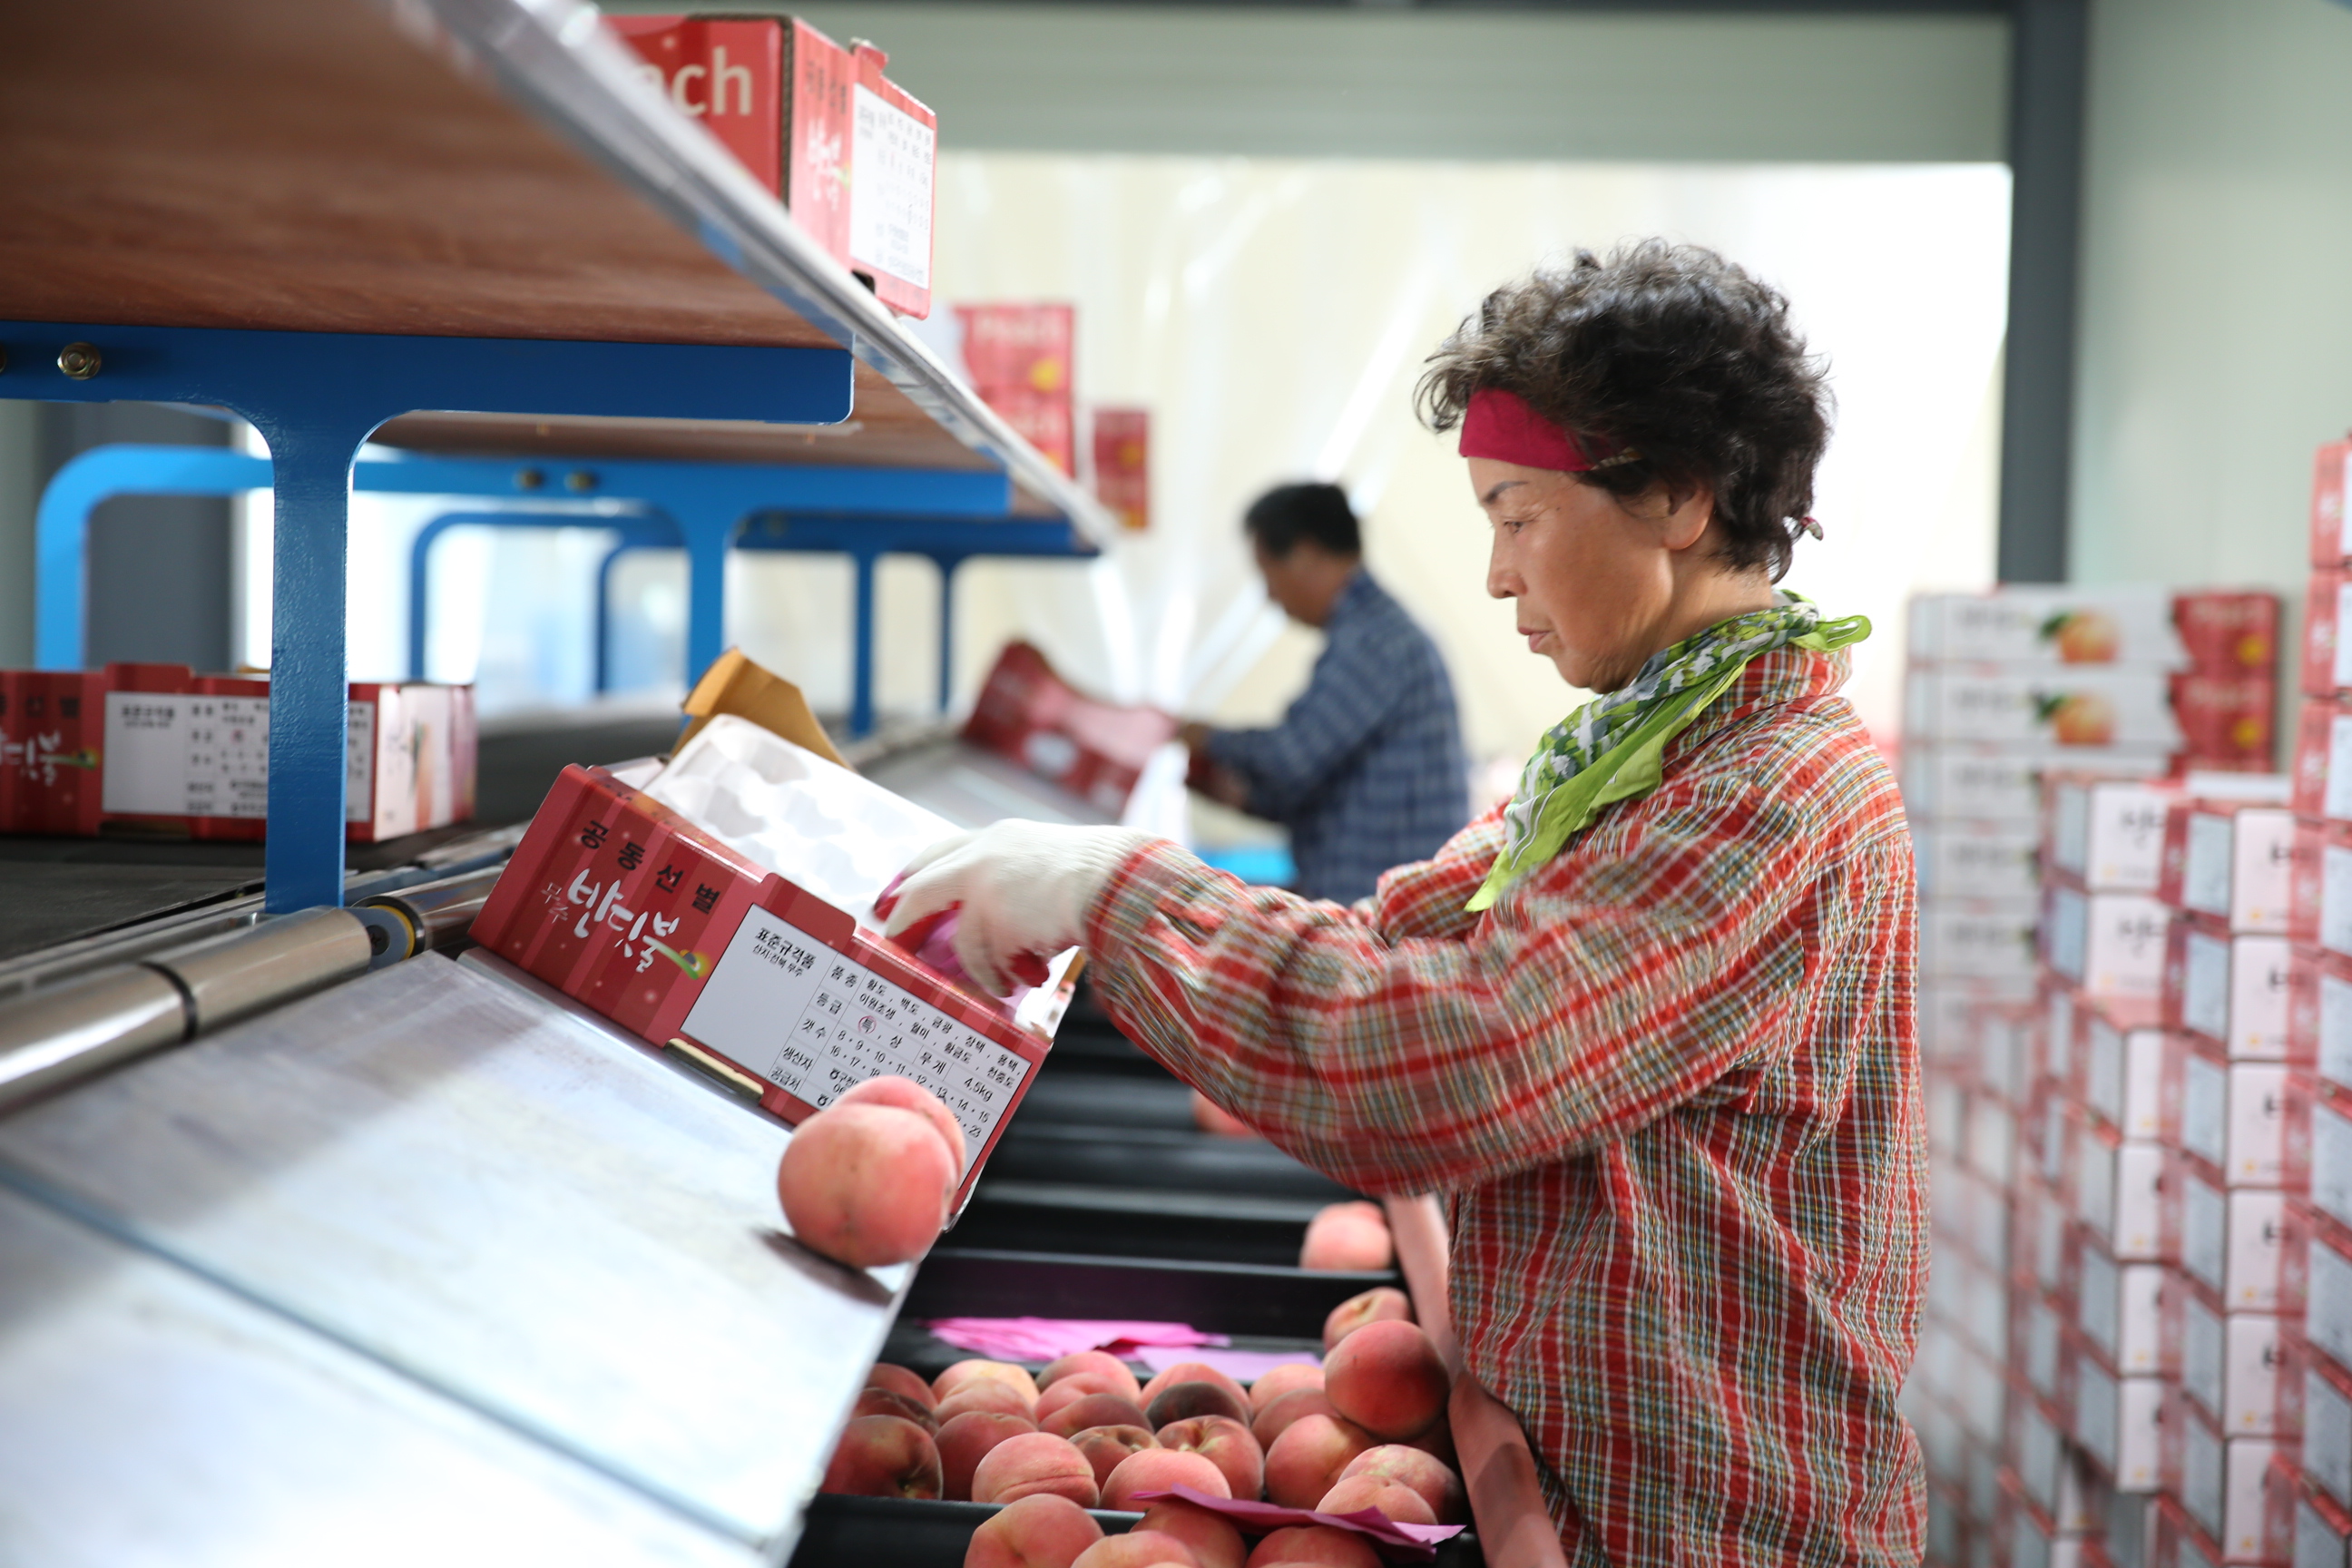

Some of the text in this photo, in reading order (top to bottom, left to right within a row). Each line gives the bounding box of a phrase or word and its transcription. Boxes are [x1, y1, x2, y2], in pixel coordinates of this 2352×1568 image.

[754, 926, 817, 971] 표준규격품
[782, 1045, 814, 1074] 생산자
[769, 1065, 802, 1093] 공급처
[963, 1076, 994, 1102] 4.5kg
